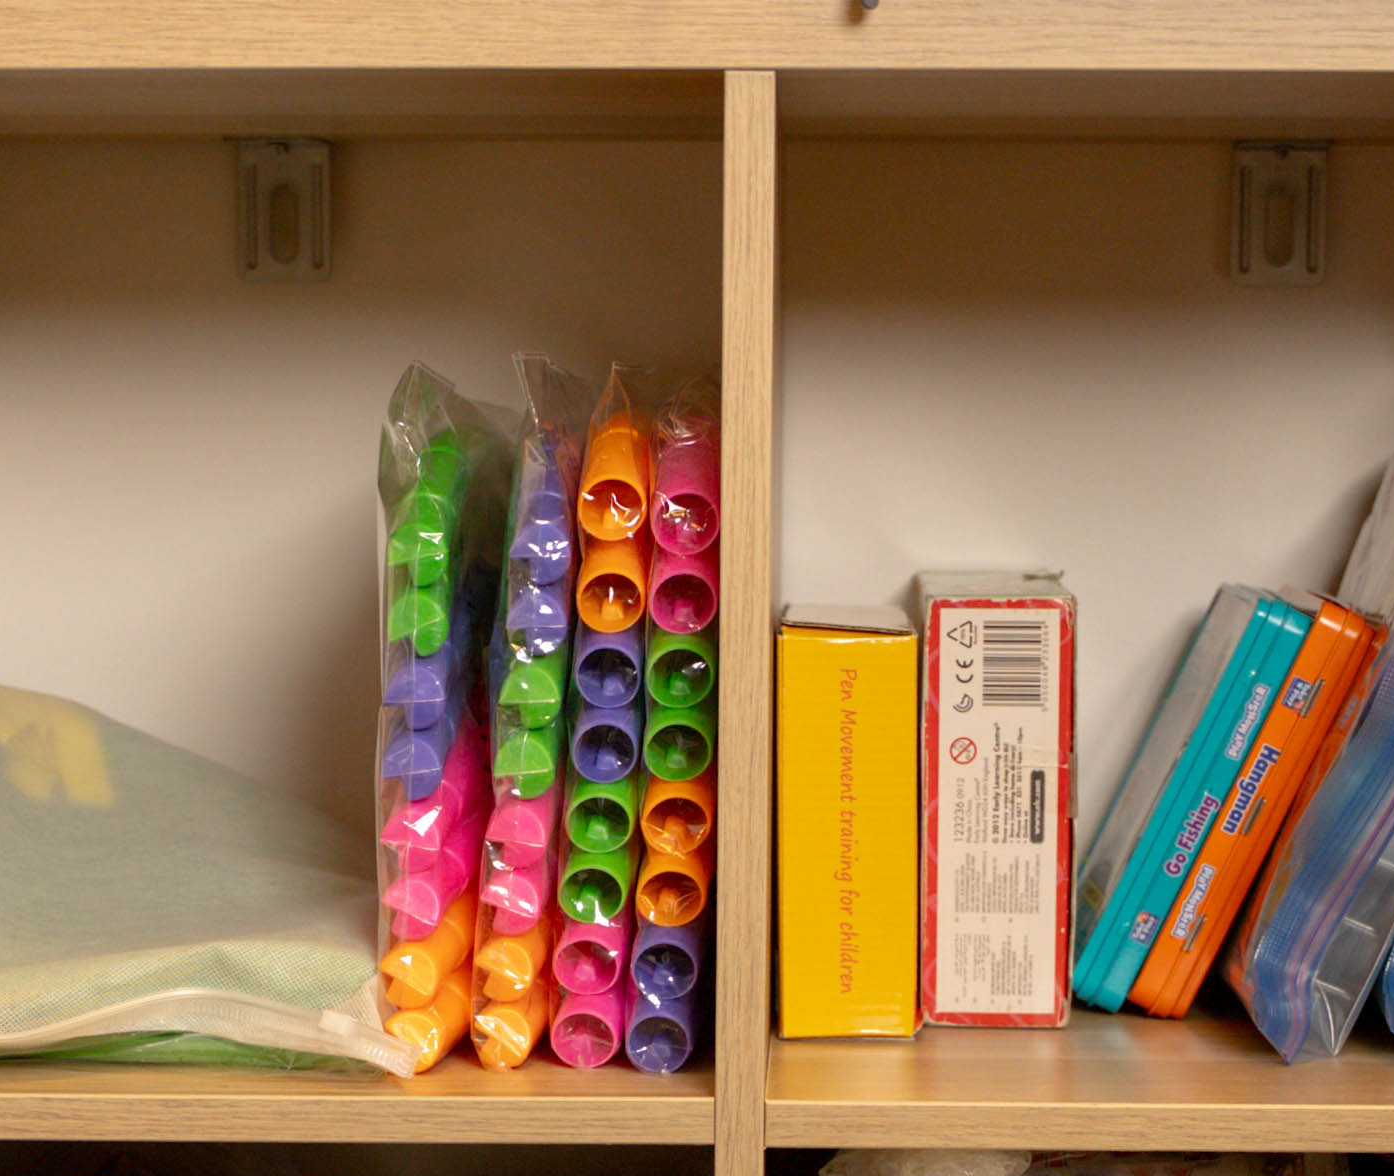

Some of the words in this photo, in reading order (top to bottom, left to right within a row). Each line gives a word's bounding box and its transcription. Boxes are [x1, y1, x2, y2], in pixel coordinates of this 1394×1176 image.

[840, 669, 858, 702] Pen
[840, 709, 856, 803] Movement
[992, 754, 1001, 789] Learning
[992, 791, 1000, 812] Early
[1222, 743, 1282, 835] Hangman
[834, 809, 859, 882] training
[954, 801, 964, 842] 123236
[1165, 850, 1188, 876] Go
[1177, 794, 1221, 852] Fishing
[839, 889, 860, 916] for
[839, 922, 859, 994] children
